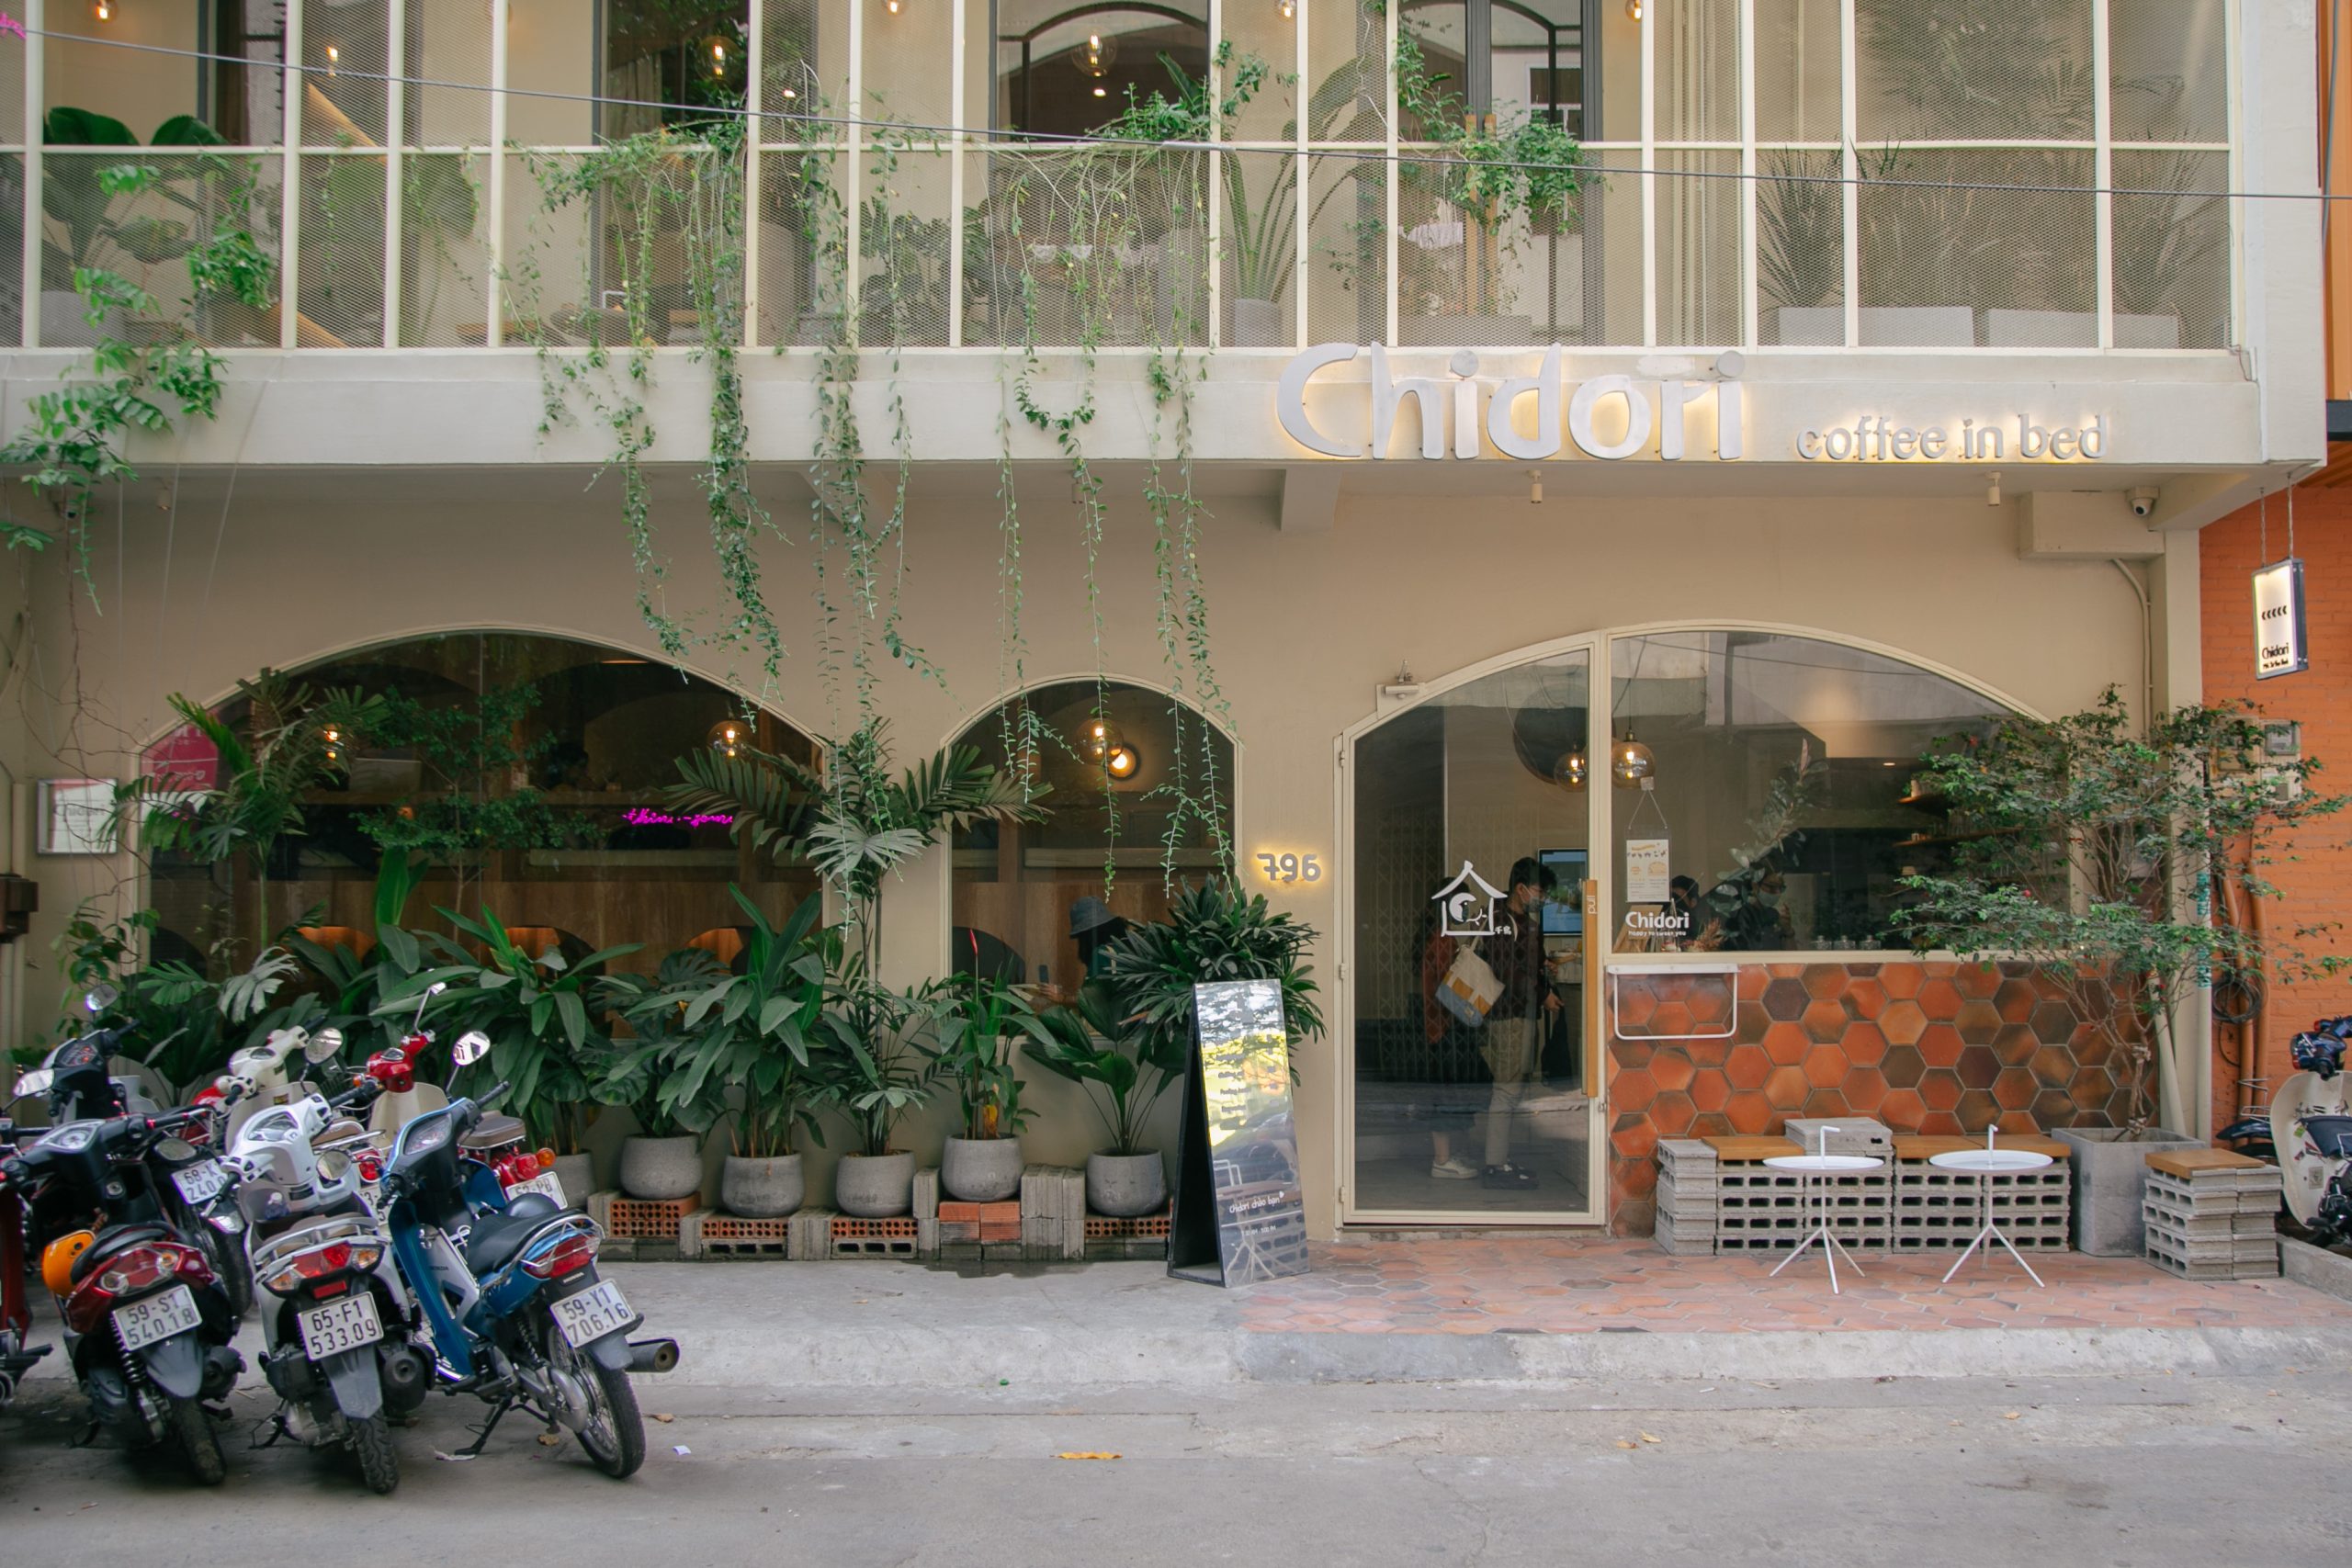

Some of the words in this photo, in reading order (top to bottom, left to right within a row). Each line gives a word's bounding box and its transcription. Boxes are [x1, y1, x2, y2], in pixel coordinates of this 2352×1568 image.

[1276, 341, 1745, 460] Chidori
[1796, 415, 1948, 460] coffee
[1962, 417, 2005, 459] in
[2019, 413, 2108, 460] bed
[2262, 643, 2289, 659] Chidori
[1256, 852, 1322, 882] 796
[1586, 895, 1598, 914] pull
[1625, 911, 1690, 929] Chidori
[127, 1292, 180, 1325] 59-S1
[311, 1300, 363, 1332] 65-F1
[562, 1287, 612, 1321] 59-Y1
[127, 1307, 195, 1346] 540.18
[310, 1318, 378, 1355] 533.09
[567, 1303, 629, 1345] 706.16
